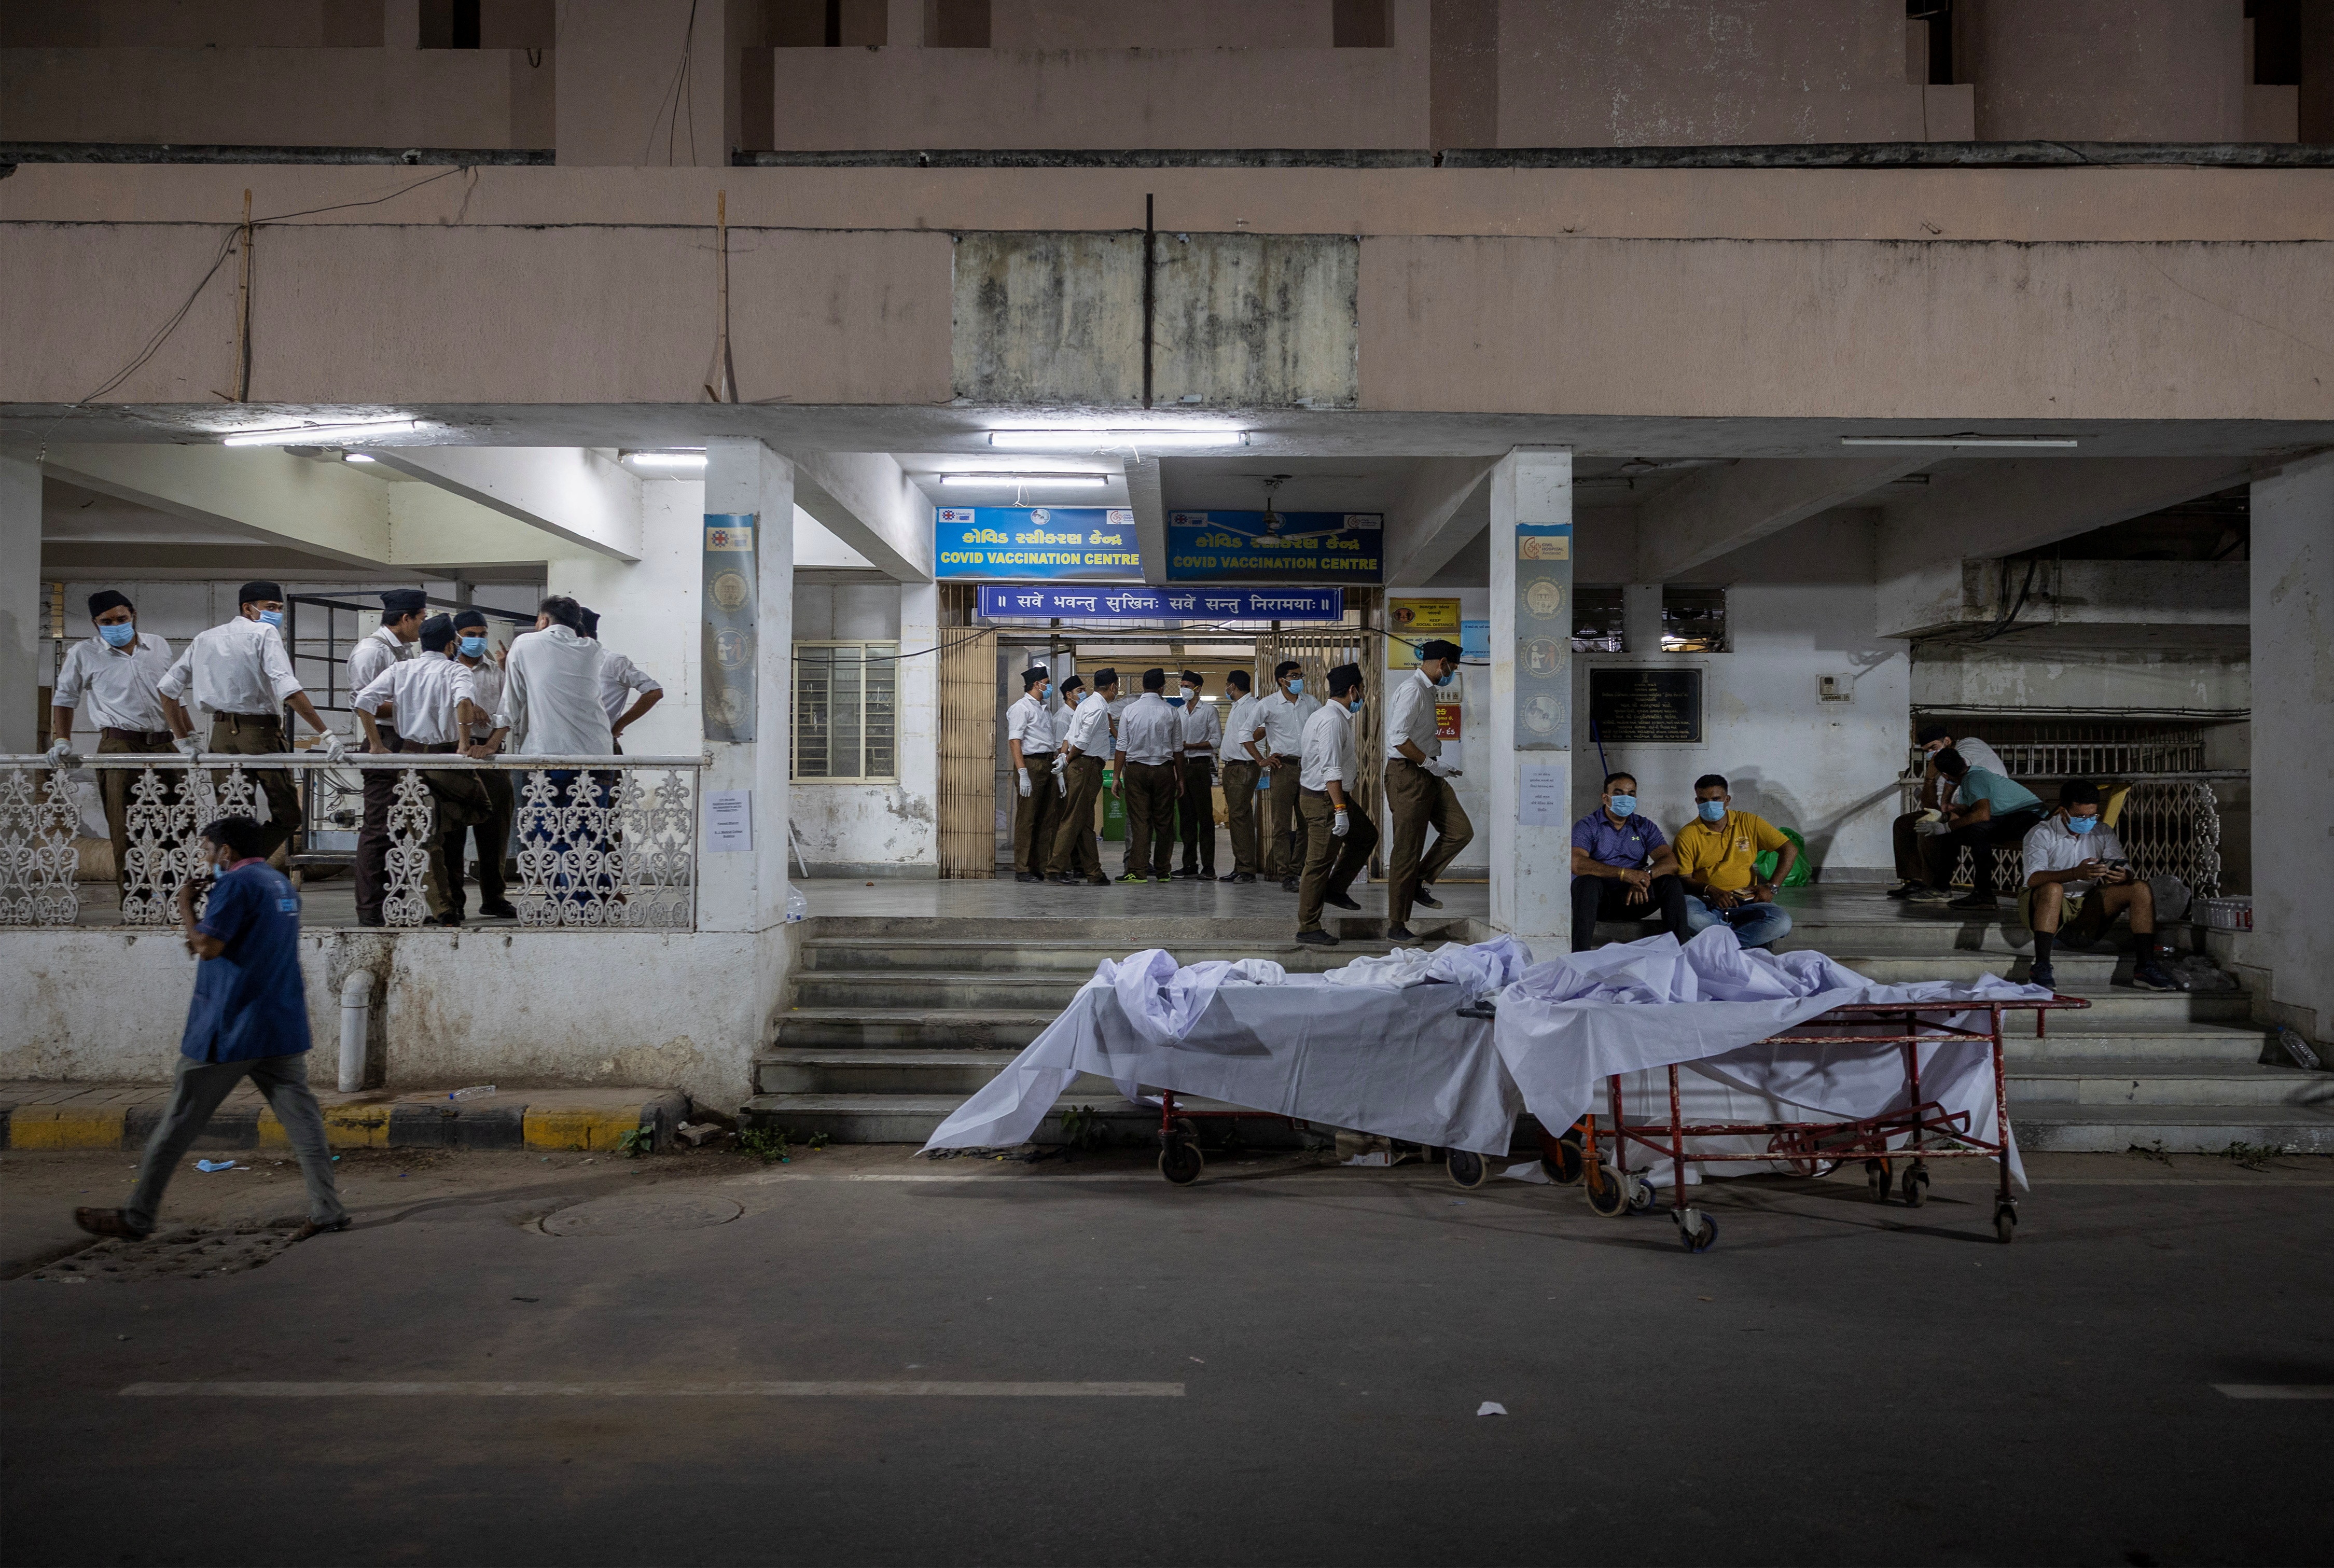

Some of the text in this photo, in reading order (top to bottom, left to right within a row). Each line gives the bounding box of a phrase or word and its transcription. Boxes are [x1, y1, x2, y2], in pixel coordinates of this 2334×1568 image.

[962, 529, 1122, 546] કોવિડ રસીકરણ કેન્દ્ર
[1196, 532, 1360, 550] કોવિડ રકરણ કેન્દ્ર
[941, 552, 1140, 565] COVID VACCINATION CENTRE
[1173, 556, 1378, 570] COVID VACCINATION CENTRE
[1016, 591, 1044, 608] सर्वे
[1054, 595, 1097, 612] भवन्तु
[1105, 593, 1159, 612] सुखिनः
[1169, 594, 1196, 609] सर्वे
[1204, 598, 1241, 614] सन्तु
[1248, 594, 1315, 610] निरामयाः
